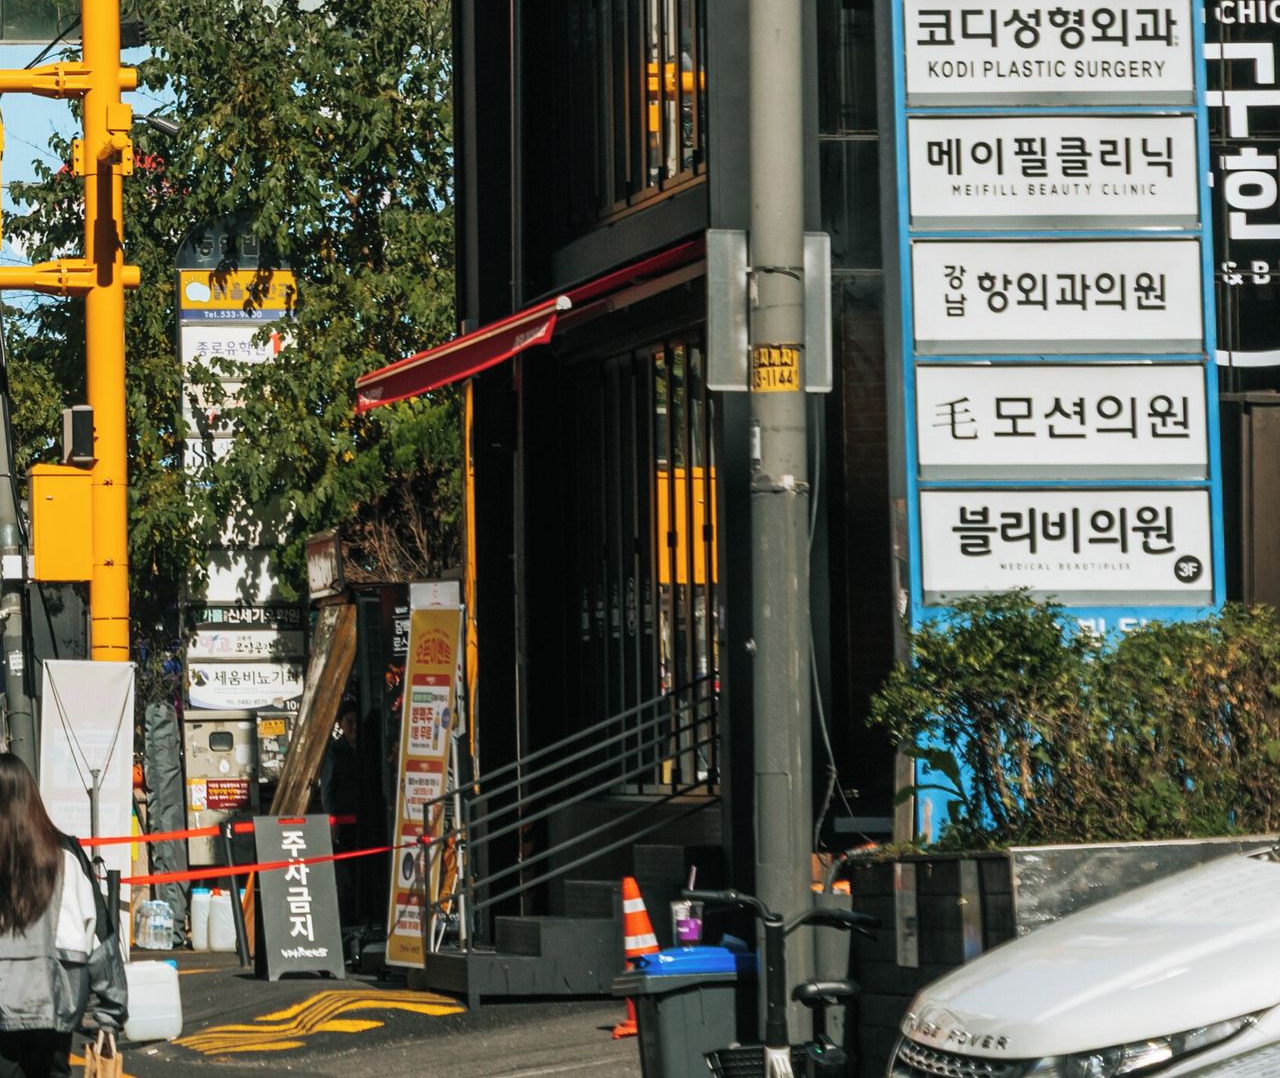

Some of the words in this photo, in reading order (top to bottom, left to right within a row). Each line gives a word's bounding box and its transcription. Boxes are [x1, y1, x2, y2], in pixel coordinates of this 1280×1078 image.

[916, 6, 1177, 49] 코디성형외과
[928, 60, 975, 78] KODI
[983, 60, 1066, 78] PLASTIC
[1074, 60, 1166, 78] SURGERY
[926, 137, 1174, 178] 메이필클리닉
[952, 184, 1018, 196] MEIFILL
[1028, 184, 1093, 196] BEAUTY
[1101, 184, 1158, 196] CLINIC
[943, 264, 967, 317] 강남
[931, 395, 980, 440] 毛
[993, 393, 1191, 440] 모션의원
[952, 506, 1176, 557] 블리비의원
[999, 562, 1050, 571] MEDICAL
[1178, 562, 1200, 577] 3F
[281, 831, 315, 942] 주차금지
